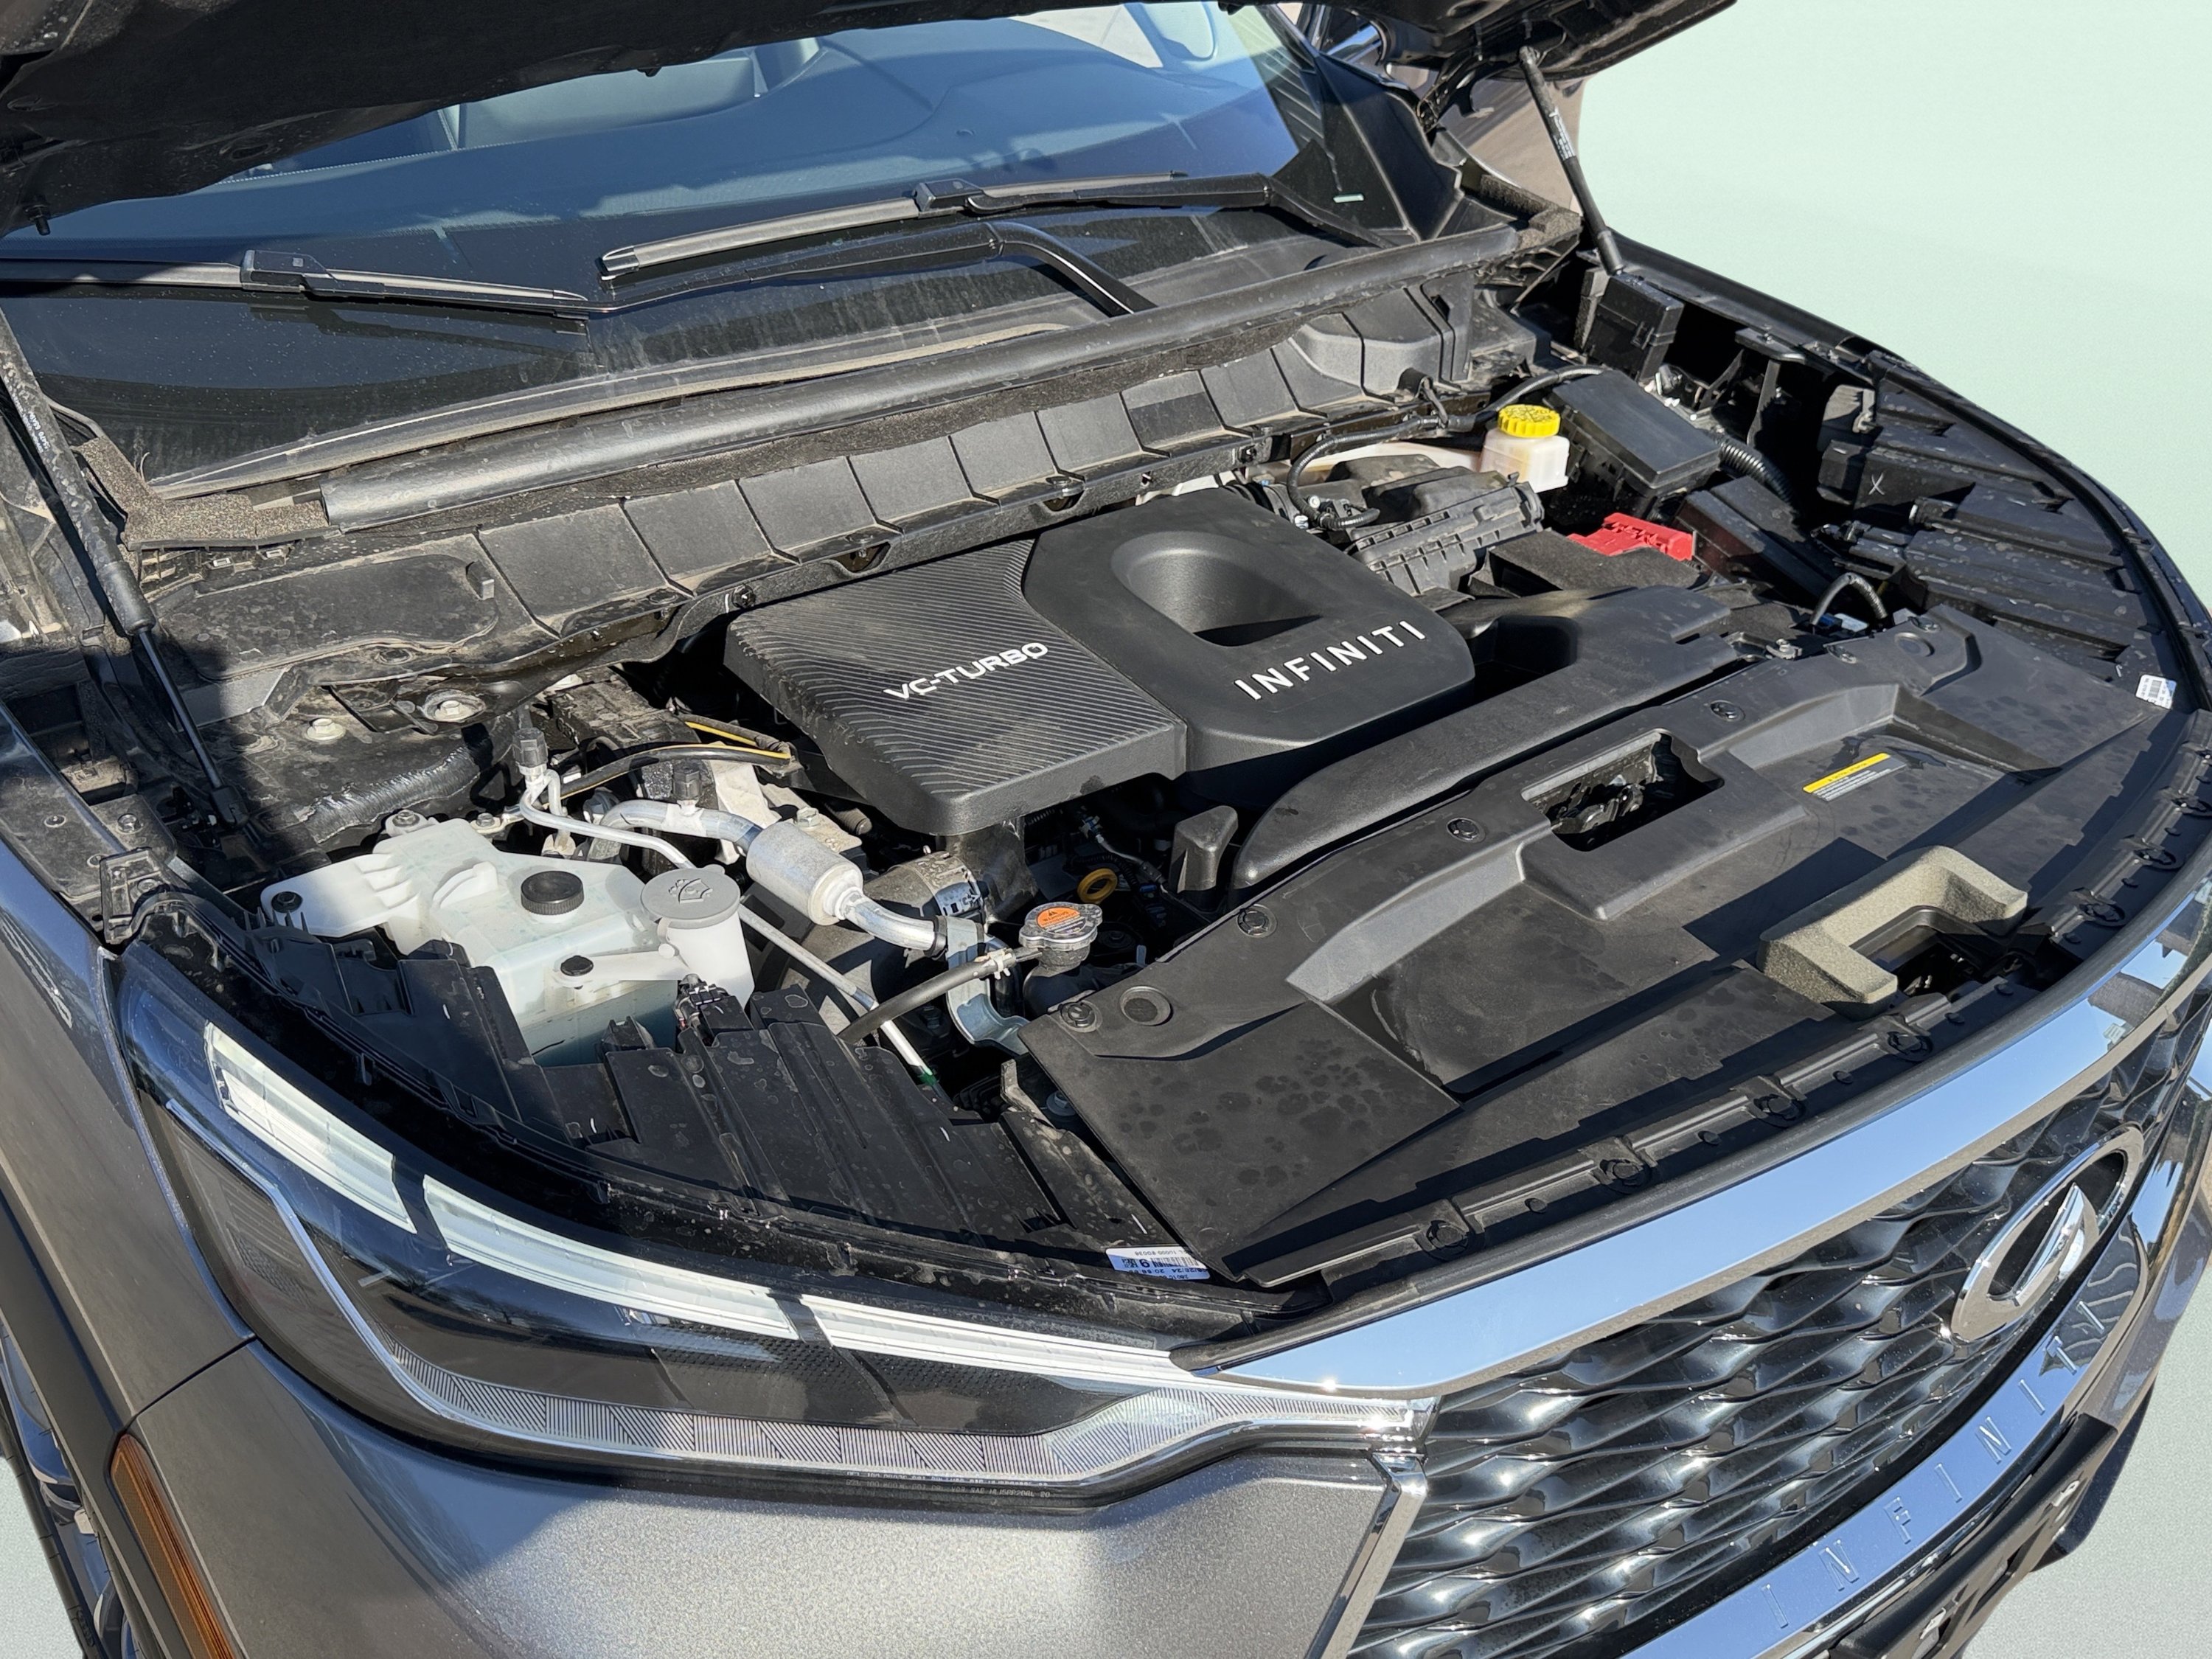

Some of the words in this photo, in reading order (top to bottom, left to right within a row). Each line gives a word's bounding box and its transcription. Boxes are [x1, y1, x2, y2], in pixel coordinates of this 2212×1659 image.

[883, 642, 1048, 700] VC-TURBO
[1234, 620, 1426, 700] INFINITI
[1139, 1259, 1150, 1268] 9
[1761, 1301, 2105, 1629] INFINITI
